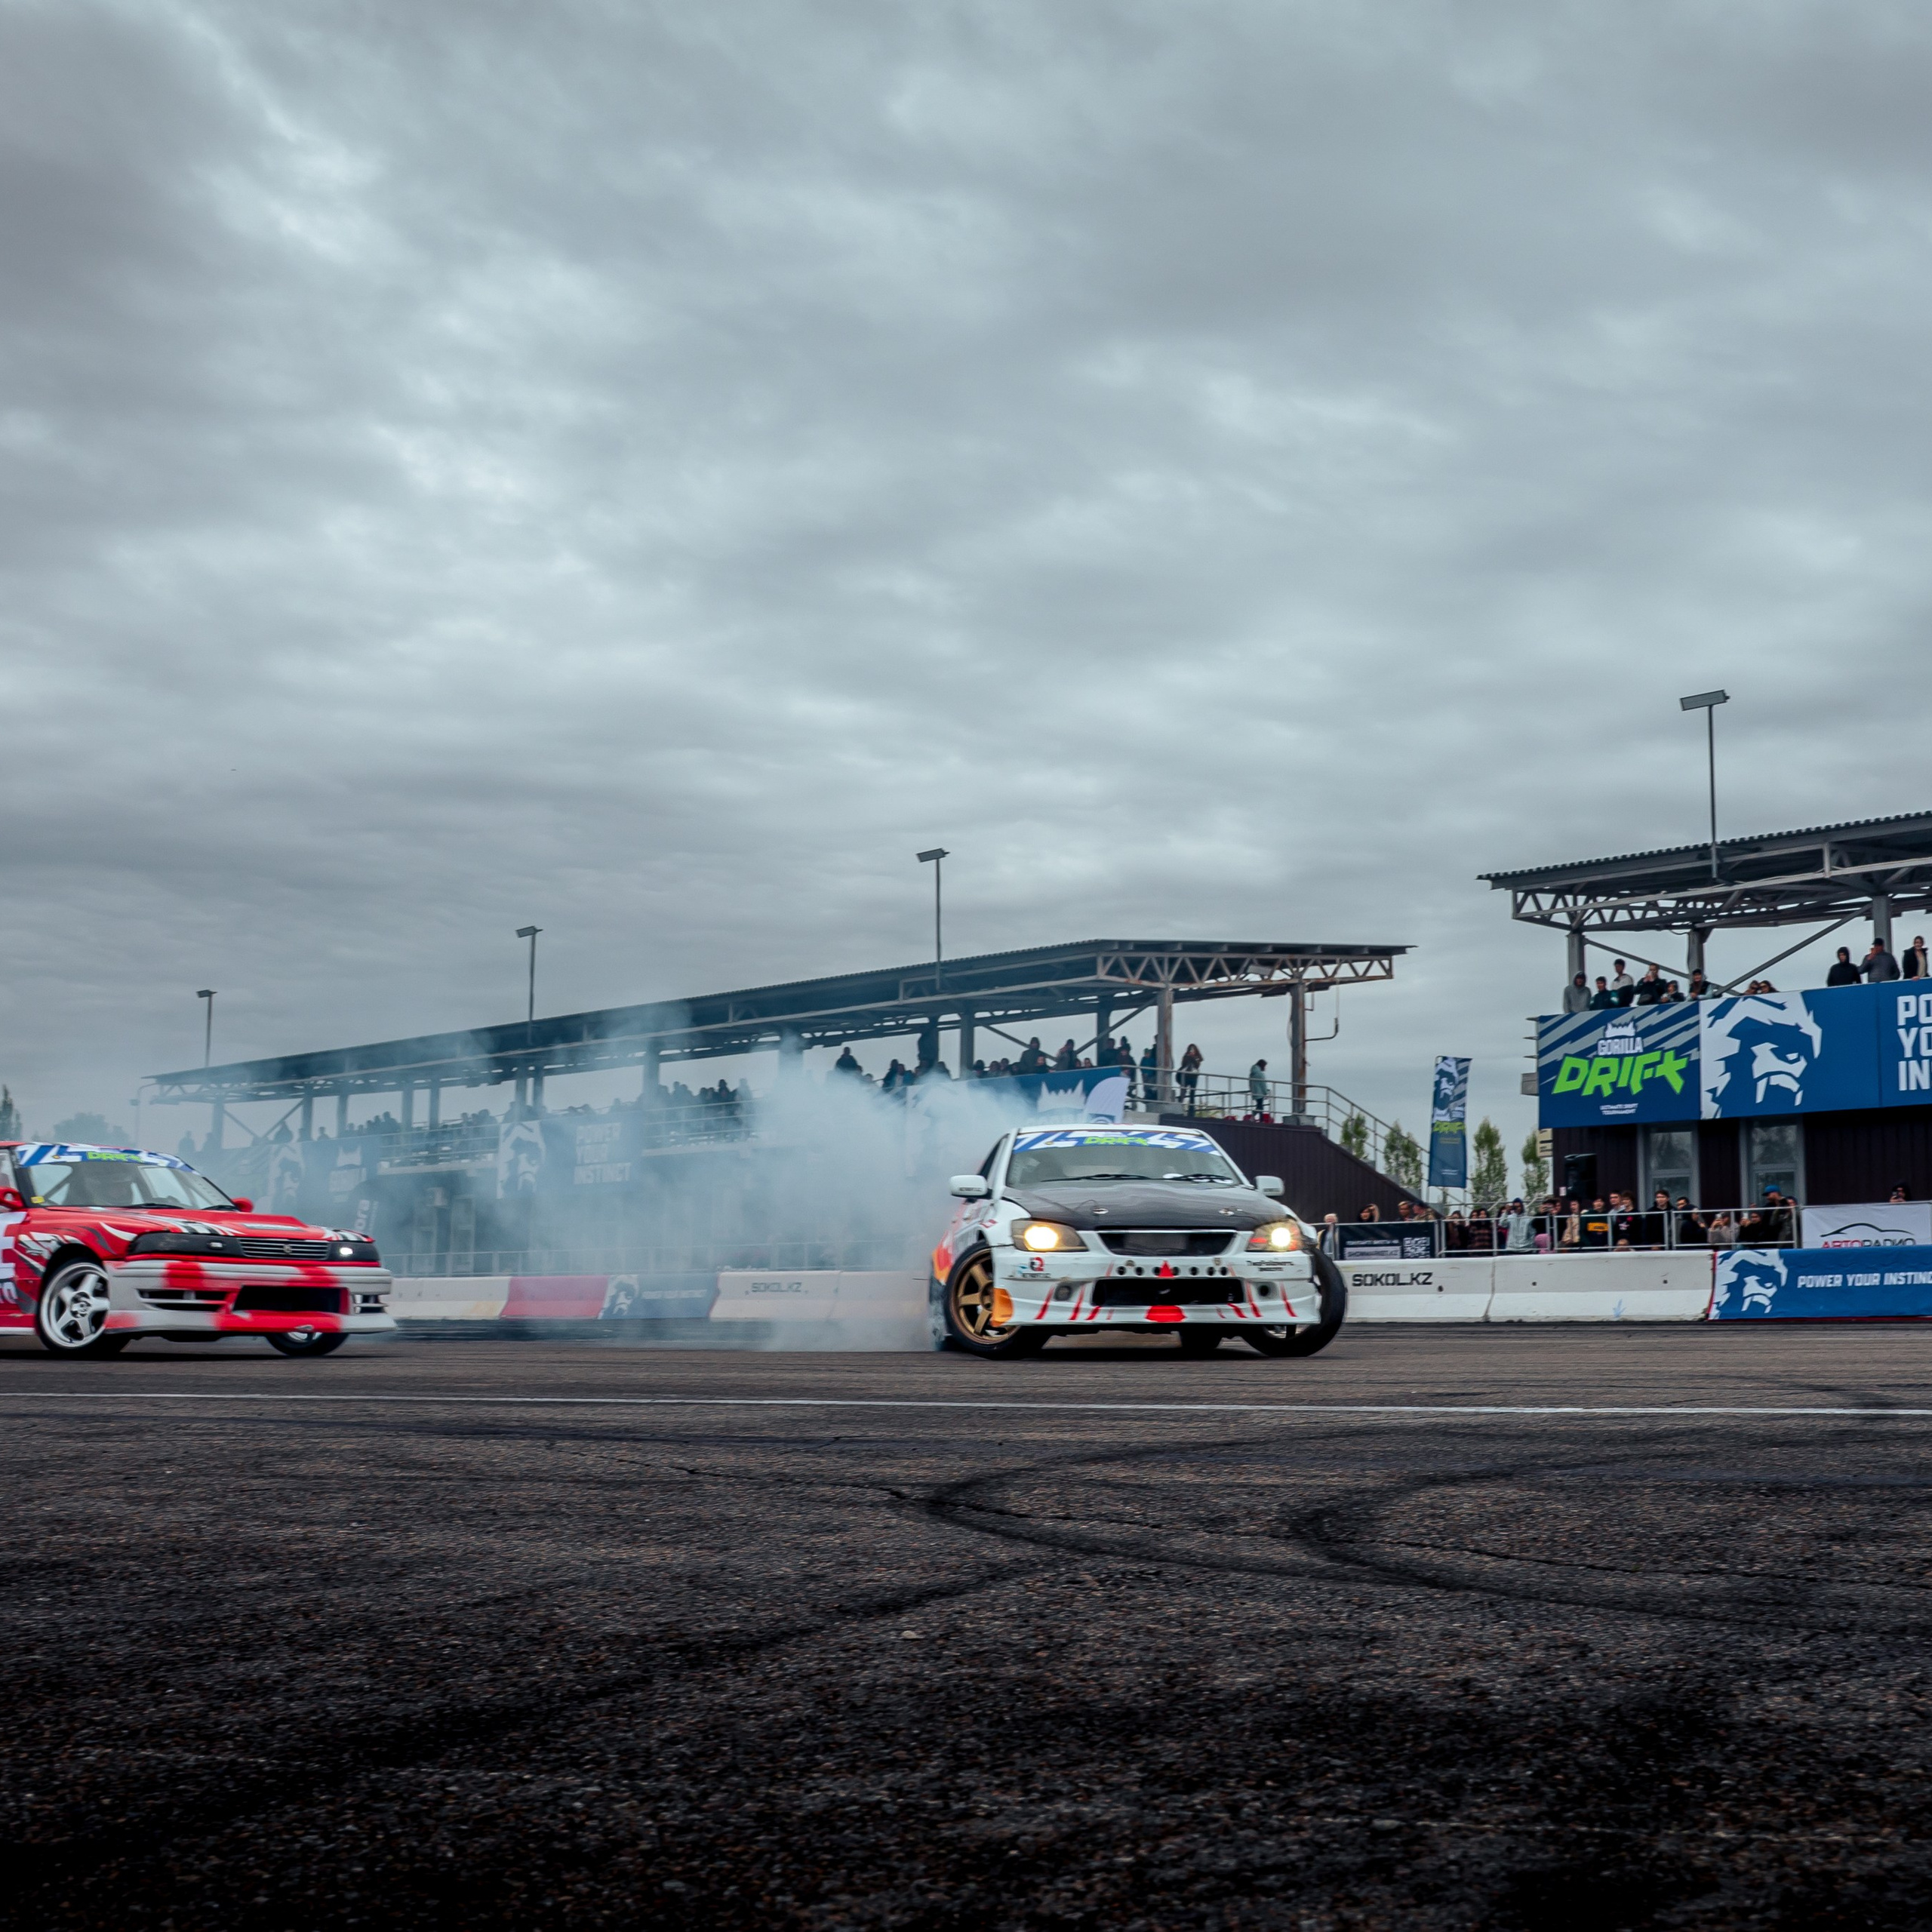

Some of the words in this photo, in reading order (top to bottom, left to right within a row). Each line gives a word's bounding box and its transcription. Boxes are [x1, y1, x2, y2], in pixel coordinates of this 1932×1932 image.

[1598, 1037, 1644, 1056] GORILLA
[1552, 1050, 1688, 1097] DRIFT
[1797, 1274, 1843, 1288] POWER
[1846, 1272, 1881, 1286] YOUR
